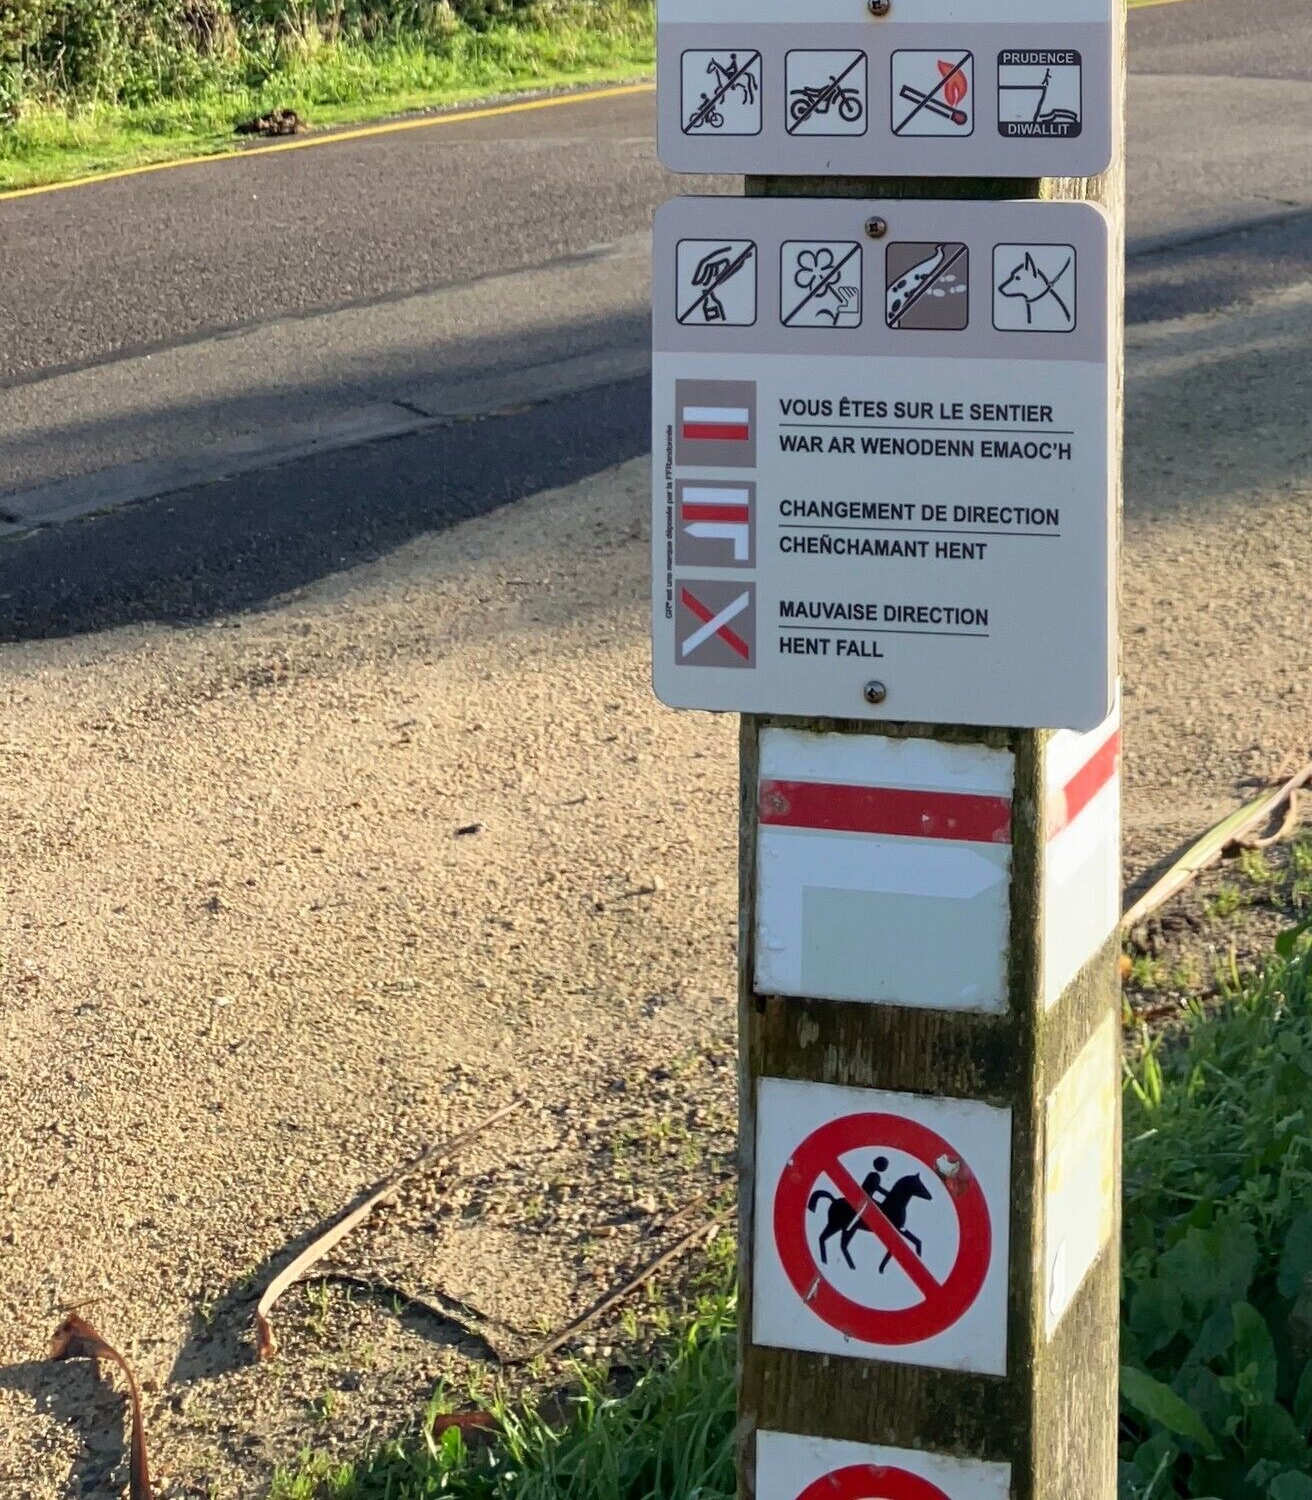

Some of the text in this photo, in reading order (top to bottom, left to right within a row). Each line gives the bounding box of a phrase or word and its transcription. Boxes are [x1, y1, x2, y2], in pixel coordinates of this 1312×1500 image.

[1004, 53, 1073, 63] PRUDENCE
[1008, 124, 1069, 134] DIWALLIT
[779, 397, 1053, 422] VOUS ÊTES SUR LE SENTIER
[780, 435, 823, 453] WAR
[828, 437, 855, 453] AR
[861, 437, 974, 457] WENODENN
[780, 500, 1058, 525] CHANGEMENT DE DIRECTION
[780, 534, 987, 559] CHEÑCHAMANT HENT
[780, 601, 988, 625] MAUVAISE DIRECTION
[780, 637, 884, 657] HENT FALL
